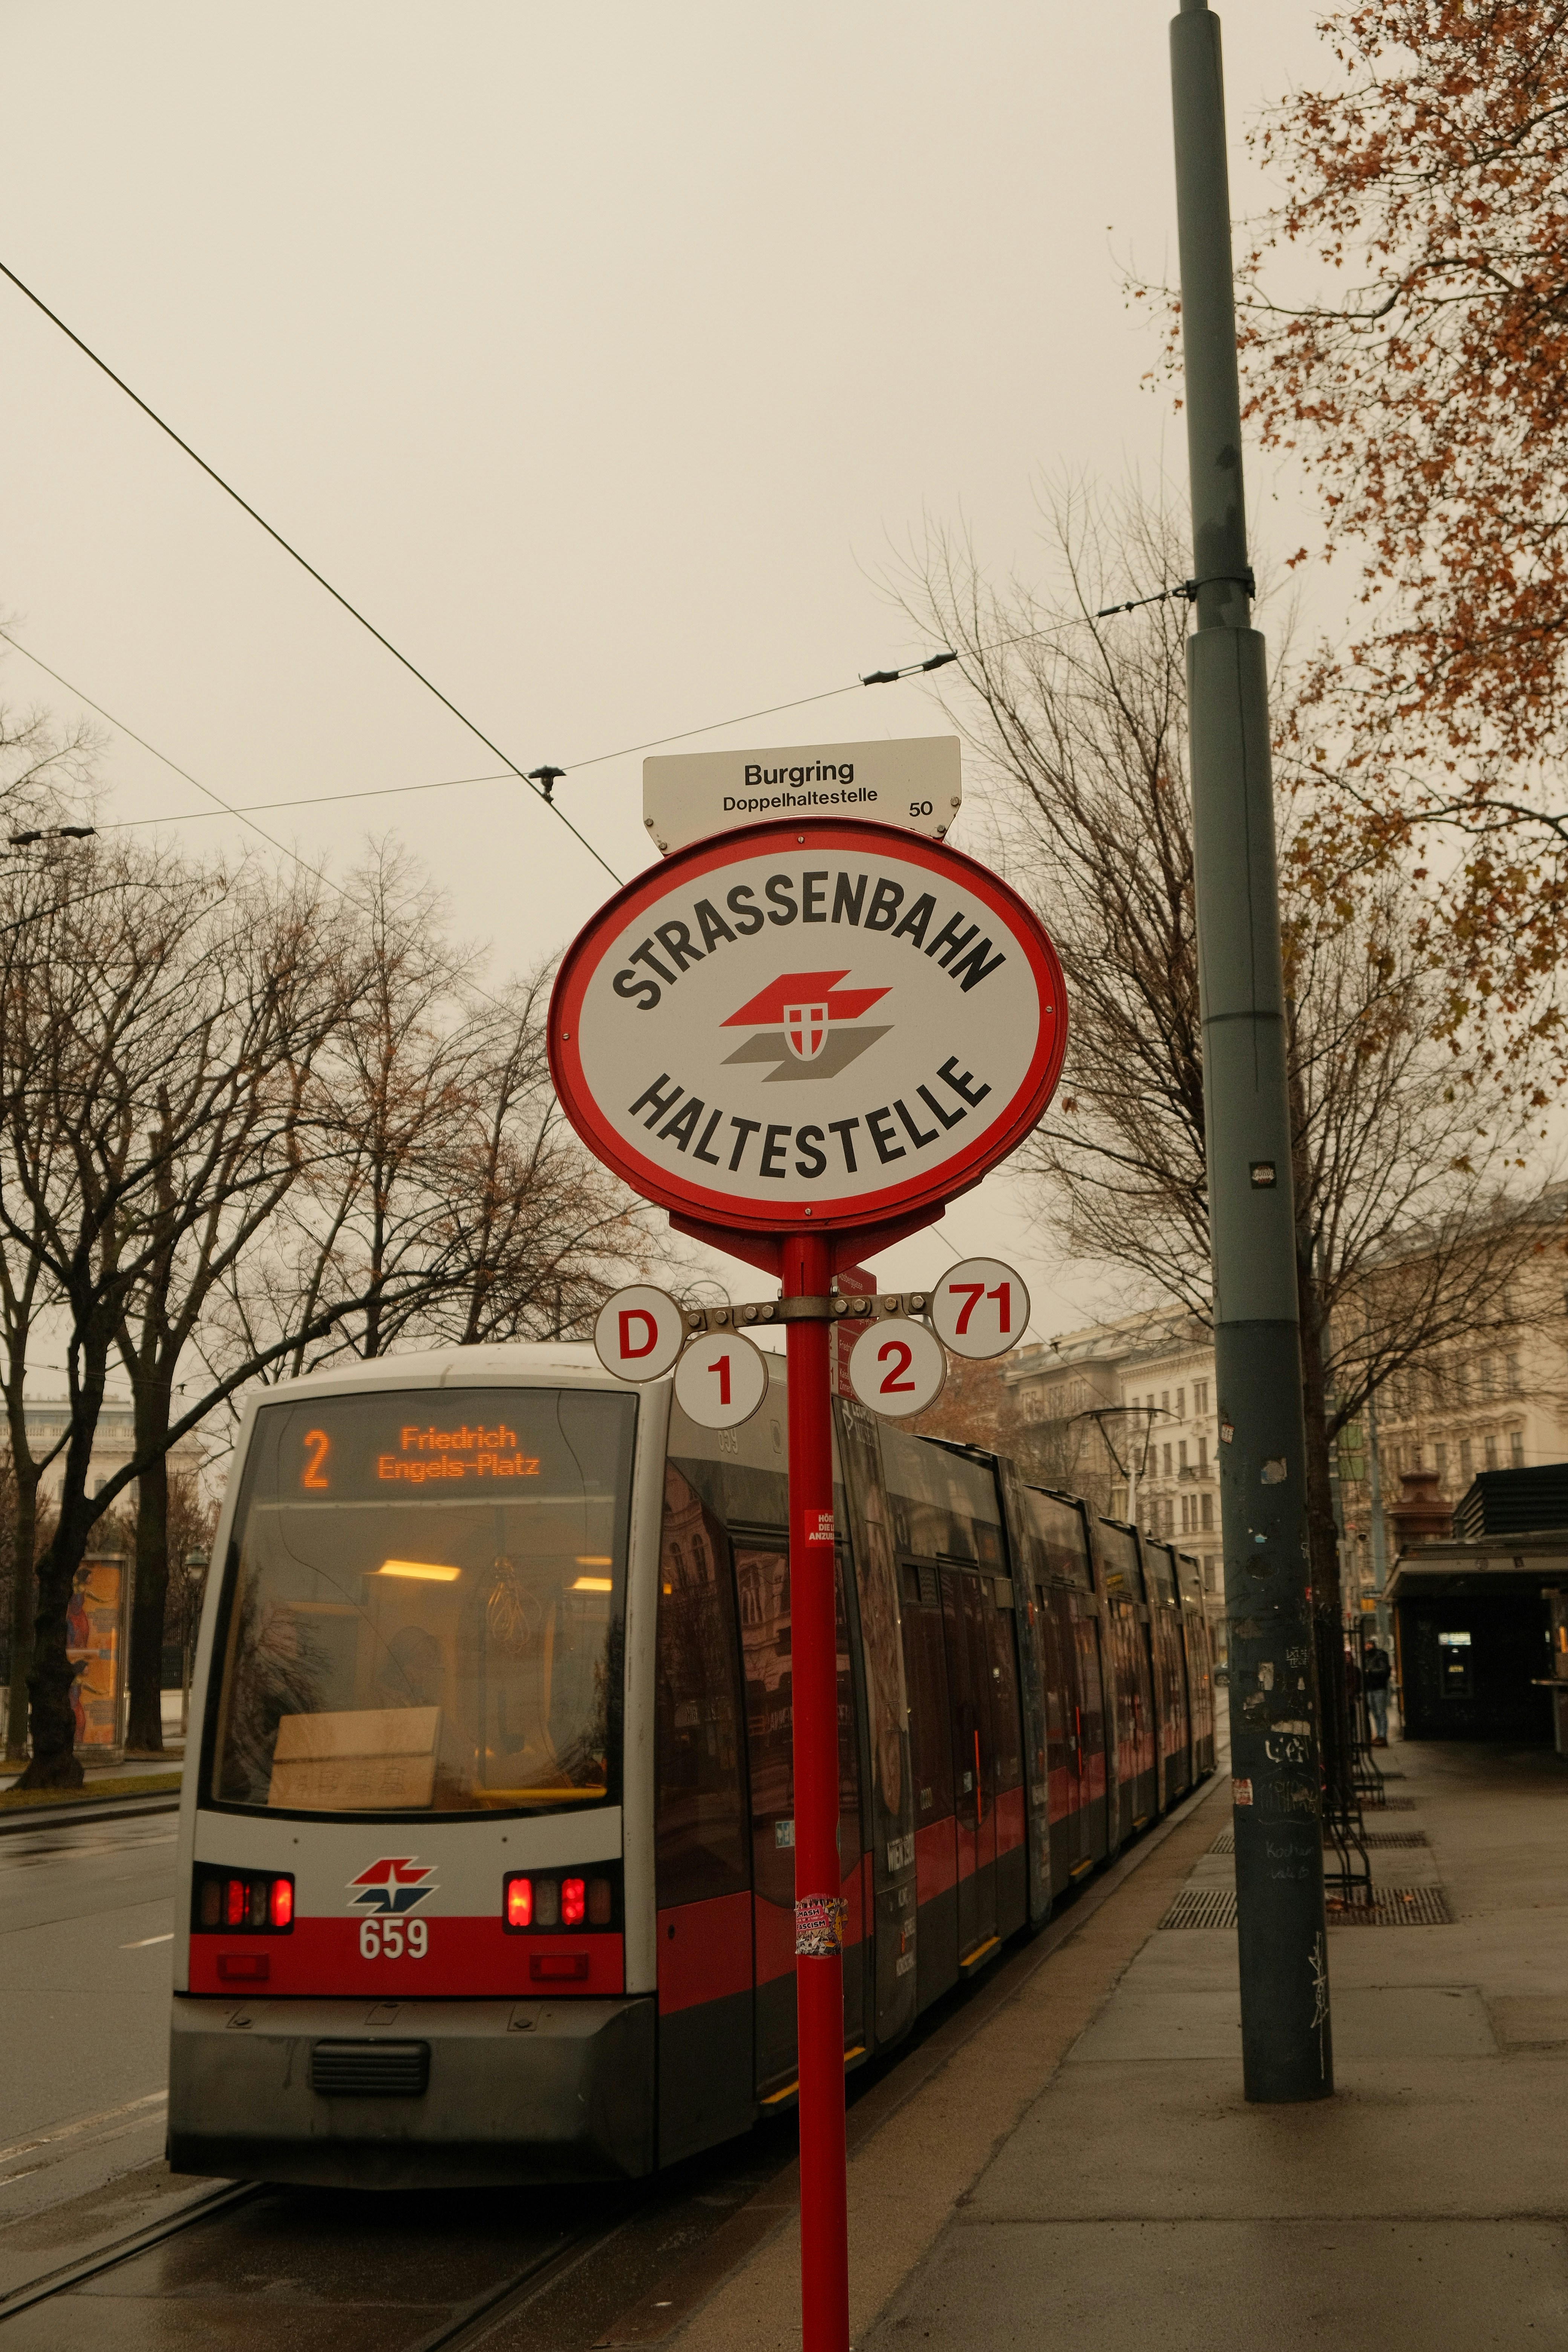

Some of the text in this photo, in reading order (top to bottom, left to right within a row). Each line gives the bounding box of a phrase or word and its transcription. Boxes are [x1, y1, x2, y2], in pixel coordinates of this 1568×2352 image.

[745, 760, 853, 787] Burgring
[724, 787, 877, 812] Doppelhaltestelle
[909, 801, 933, 817] 50
[612, 871, 1006, 1010] STRASSENBAHN
[628, 1056, 992, 1179] HALTESTELLE
[839, 1273, 863, 1290] Absberggasse
[949, 1282, 1011, 1334] 71
[619, 1309, 658, 1359] D
[708, 1355, 731, 1404] 1
[840, 1368, 849, 1380] Kaise
[877, 1341, 915, 1393] 2
[840, 1380, 853, 1396] Zinnerg
[403, 1426, 516, 1450] Friedrich
[305, 1432, 328, 1487] 2
[379, 1453, 539, 1482] Engels-Platz
[359, 1919, 429, 1959] 659
[797, 1920, 825, 1930] FASCISM
